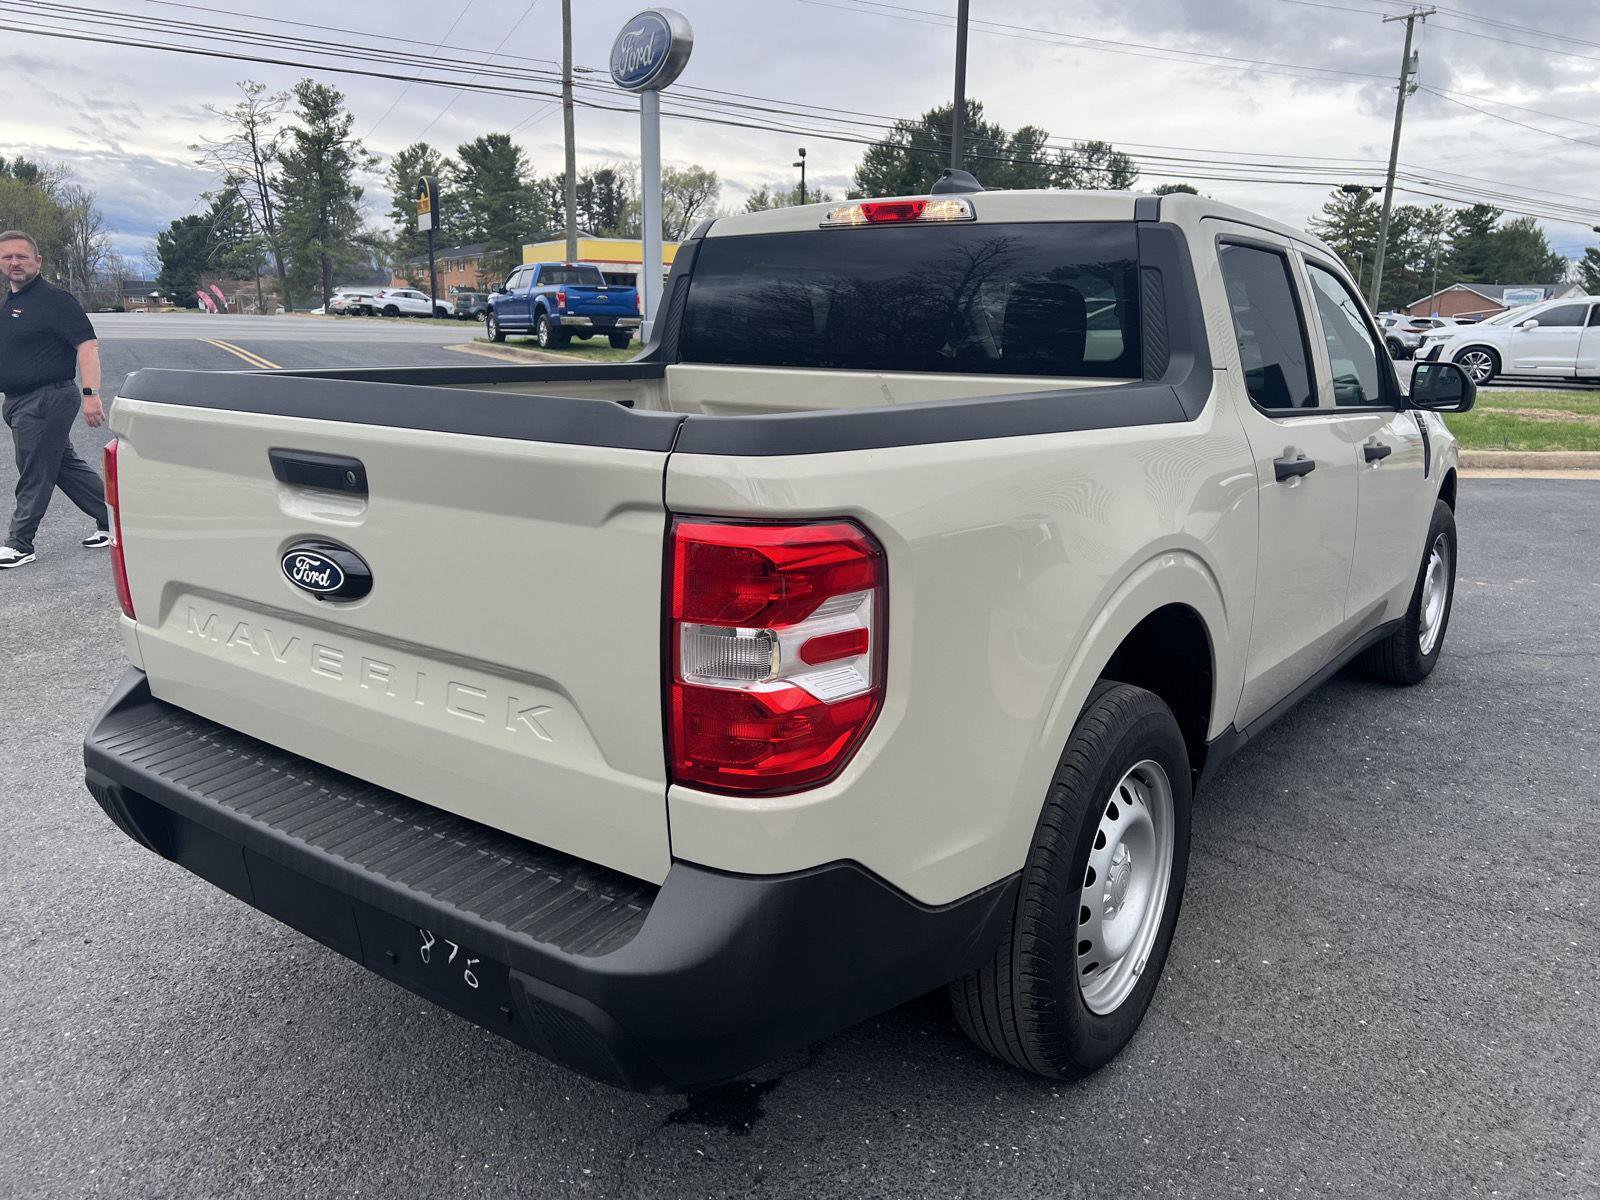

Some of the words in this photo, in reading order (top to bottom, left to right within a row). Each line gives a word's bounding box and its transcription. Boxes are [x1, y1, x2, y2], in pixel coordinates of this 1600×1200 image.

[619, 26, 655, 76] Ford
[293, 556, 331, 586] Ford
[186, 606, 553, 743] MAVERICK
